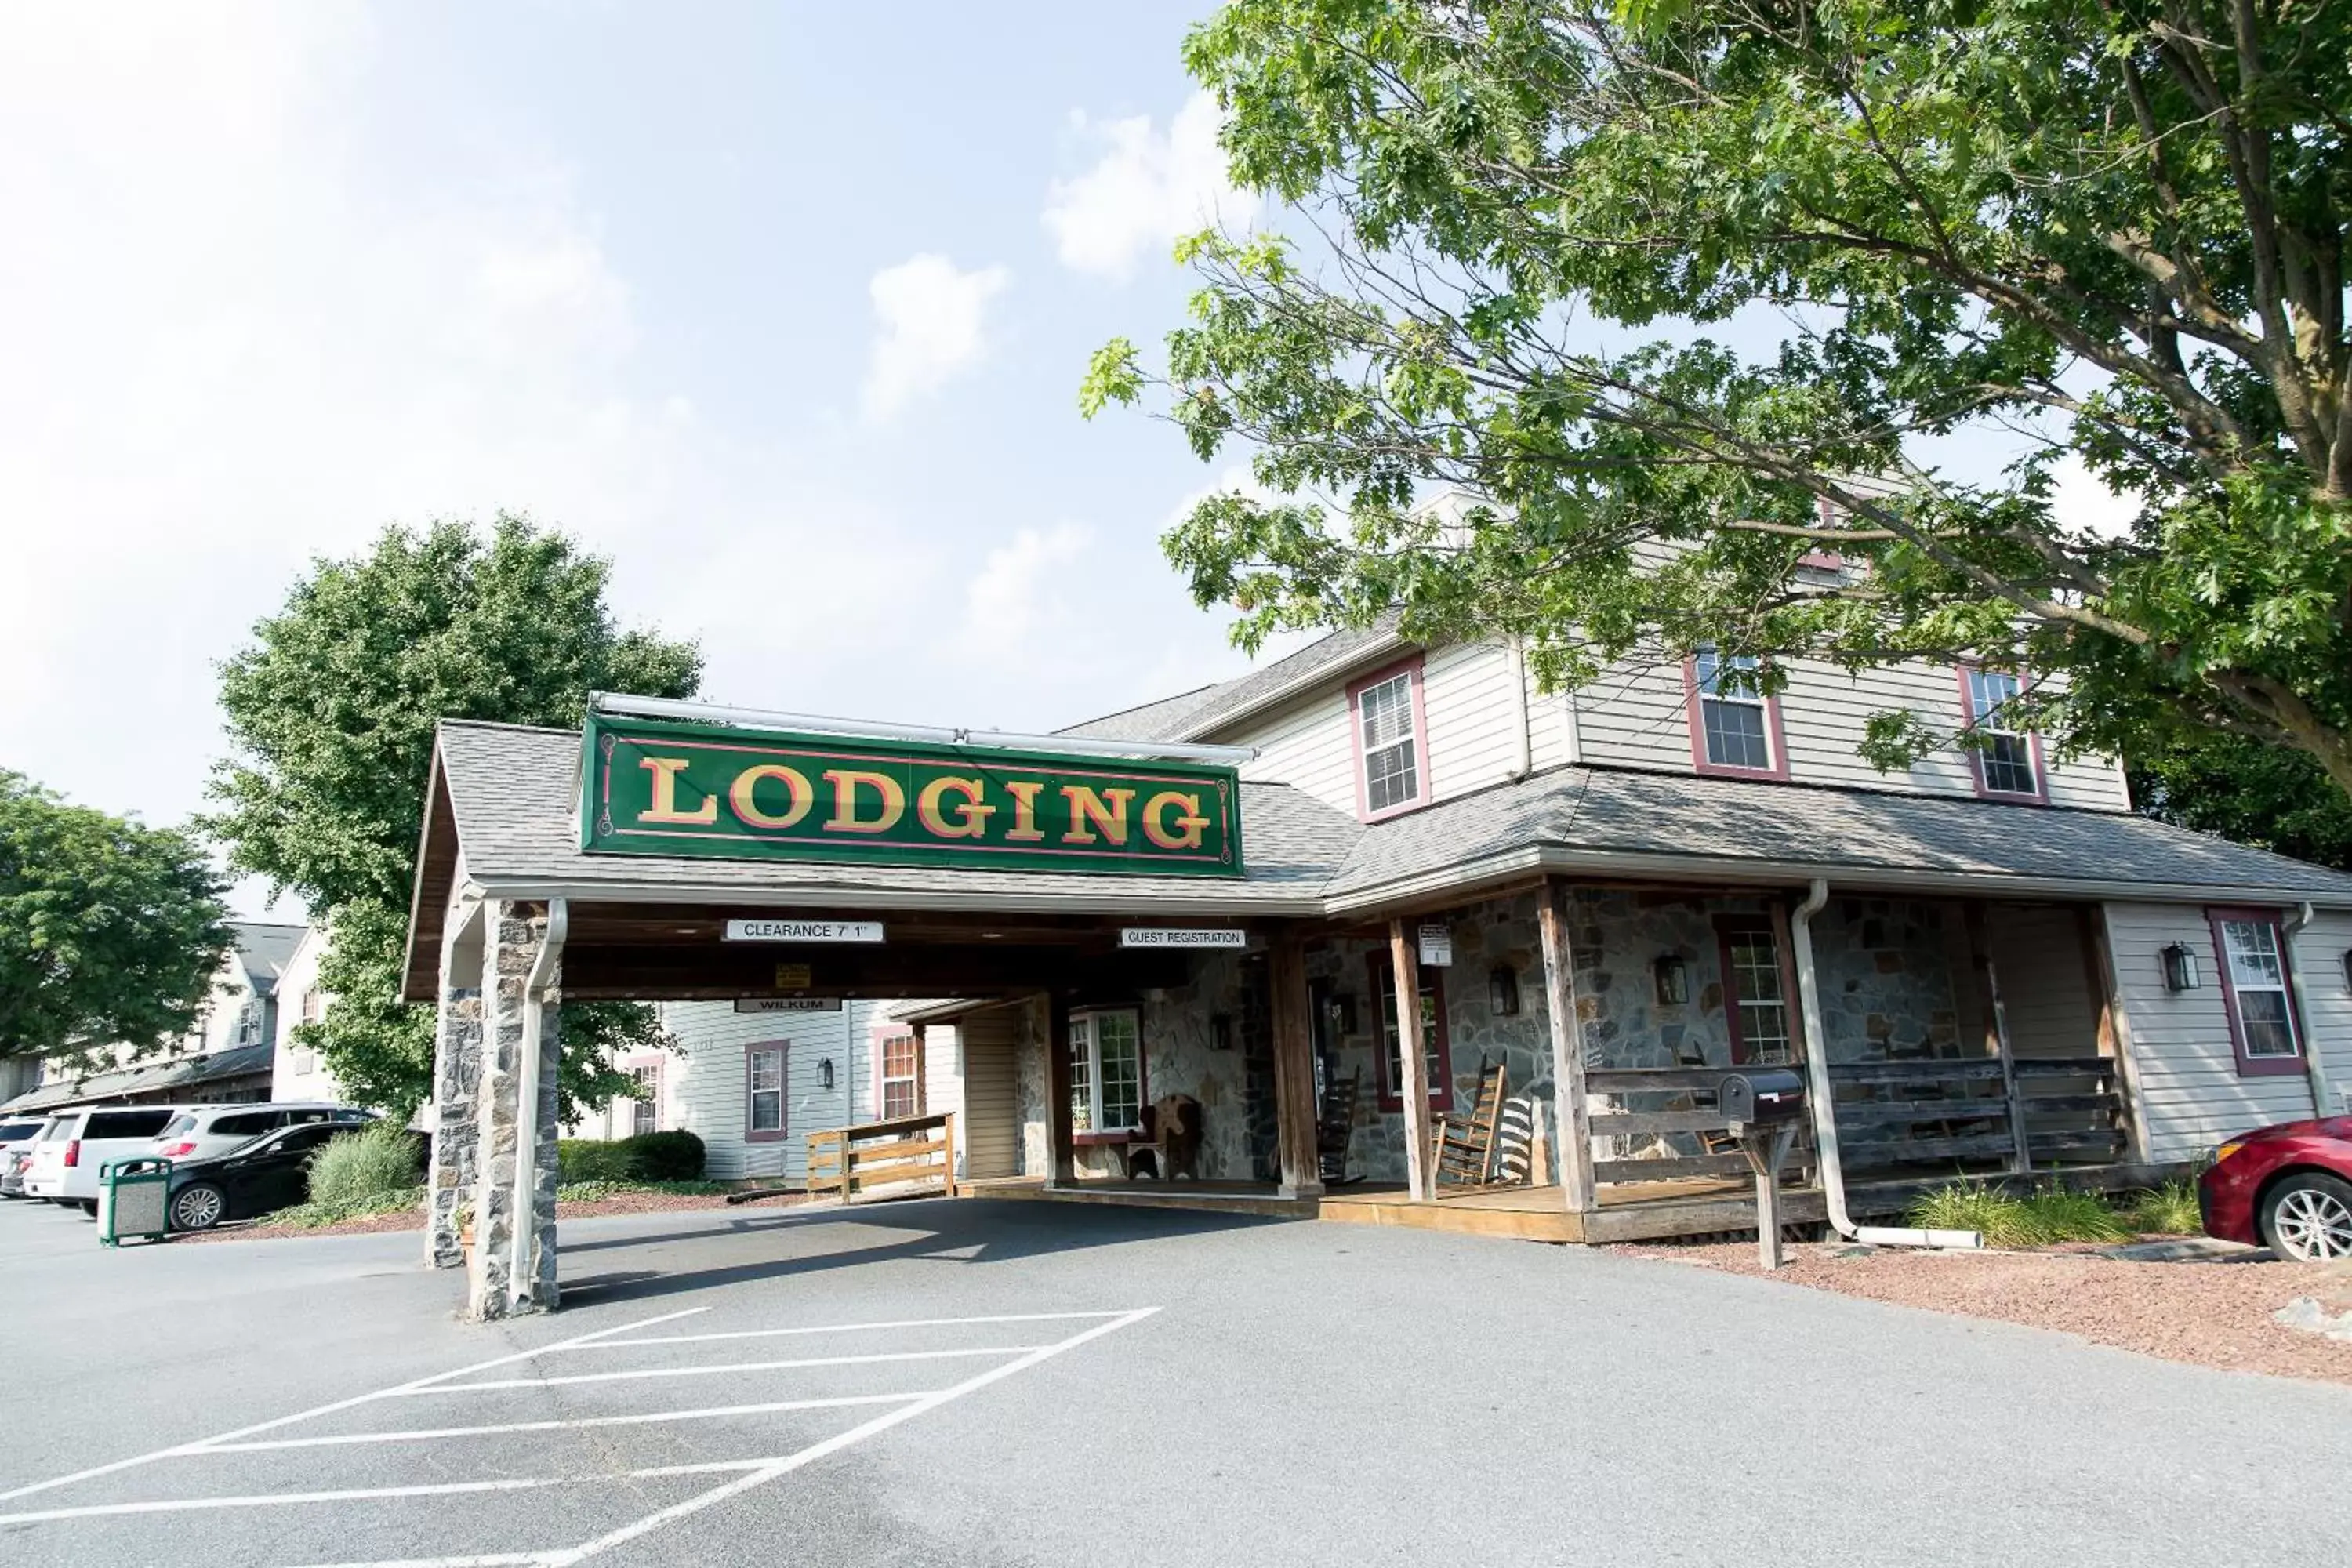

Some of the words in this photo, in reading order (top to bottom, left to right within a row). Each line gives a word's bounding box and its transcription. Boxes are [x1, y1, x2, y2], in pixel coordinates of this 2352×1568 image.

[637, 757, 1210, 849] LODGING
[744, 924, 832, 938] CLEARANCE
[1128, 931, 1163, 943] GUEST
[1167, 932, 1240, 943] REGISTRATION
[760, 1000, 824, 1010] WILKUM
